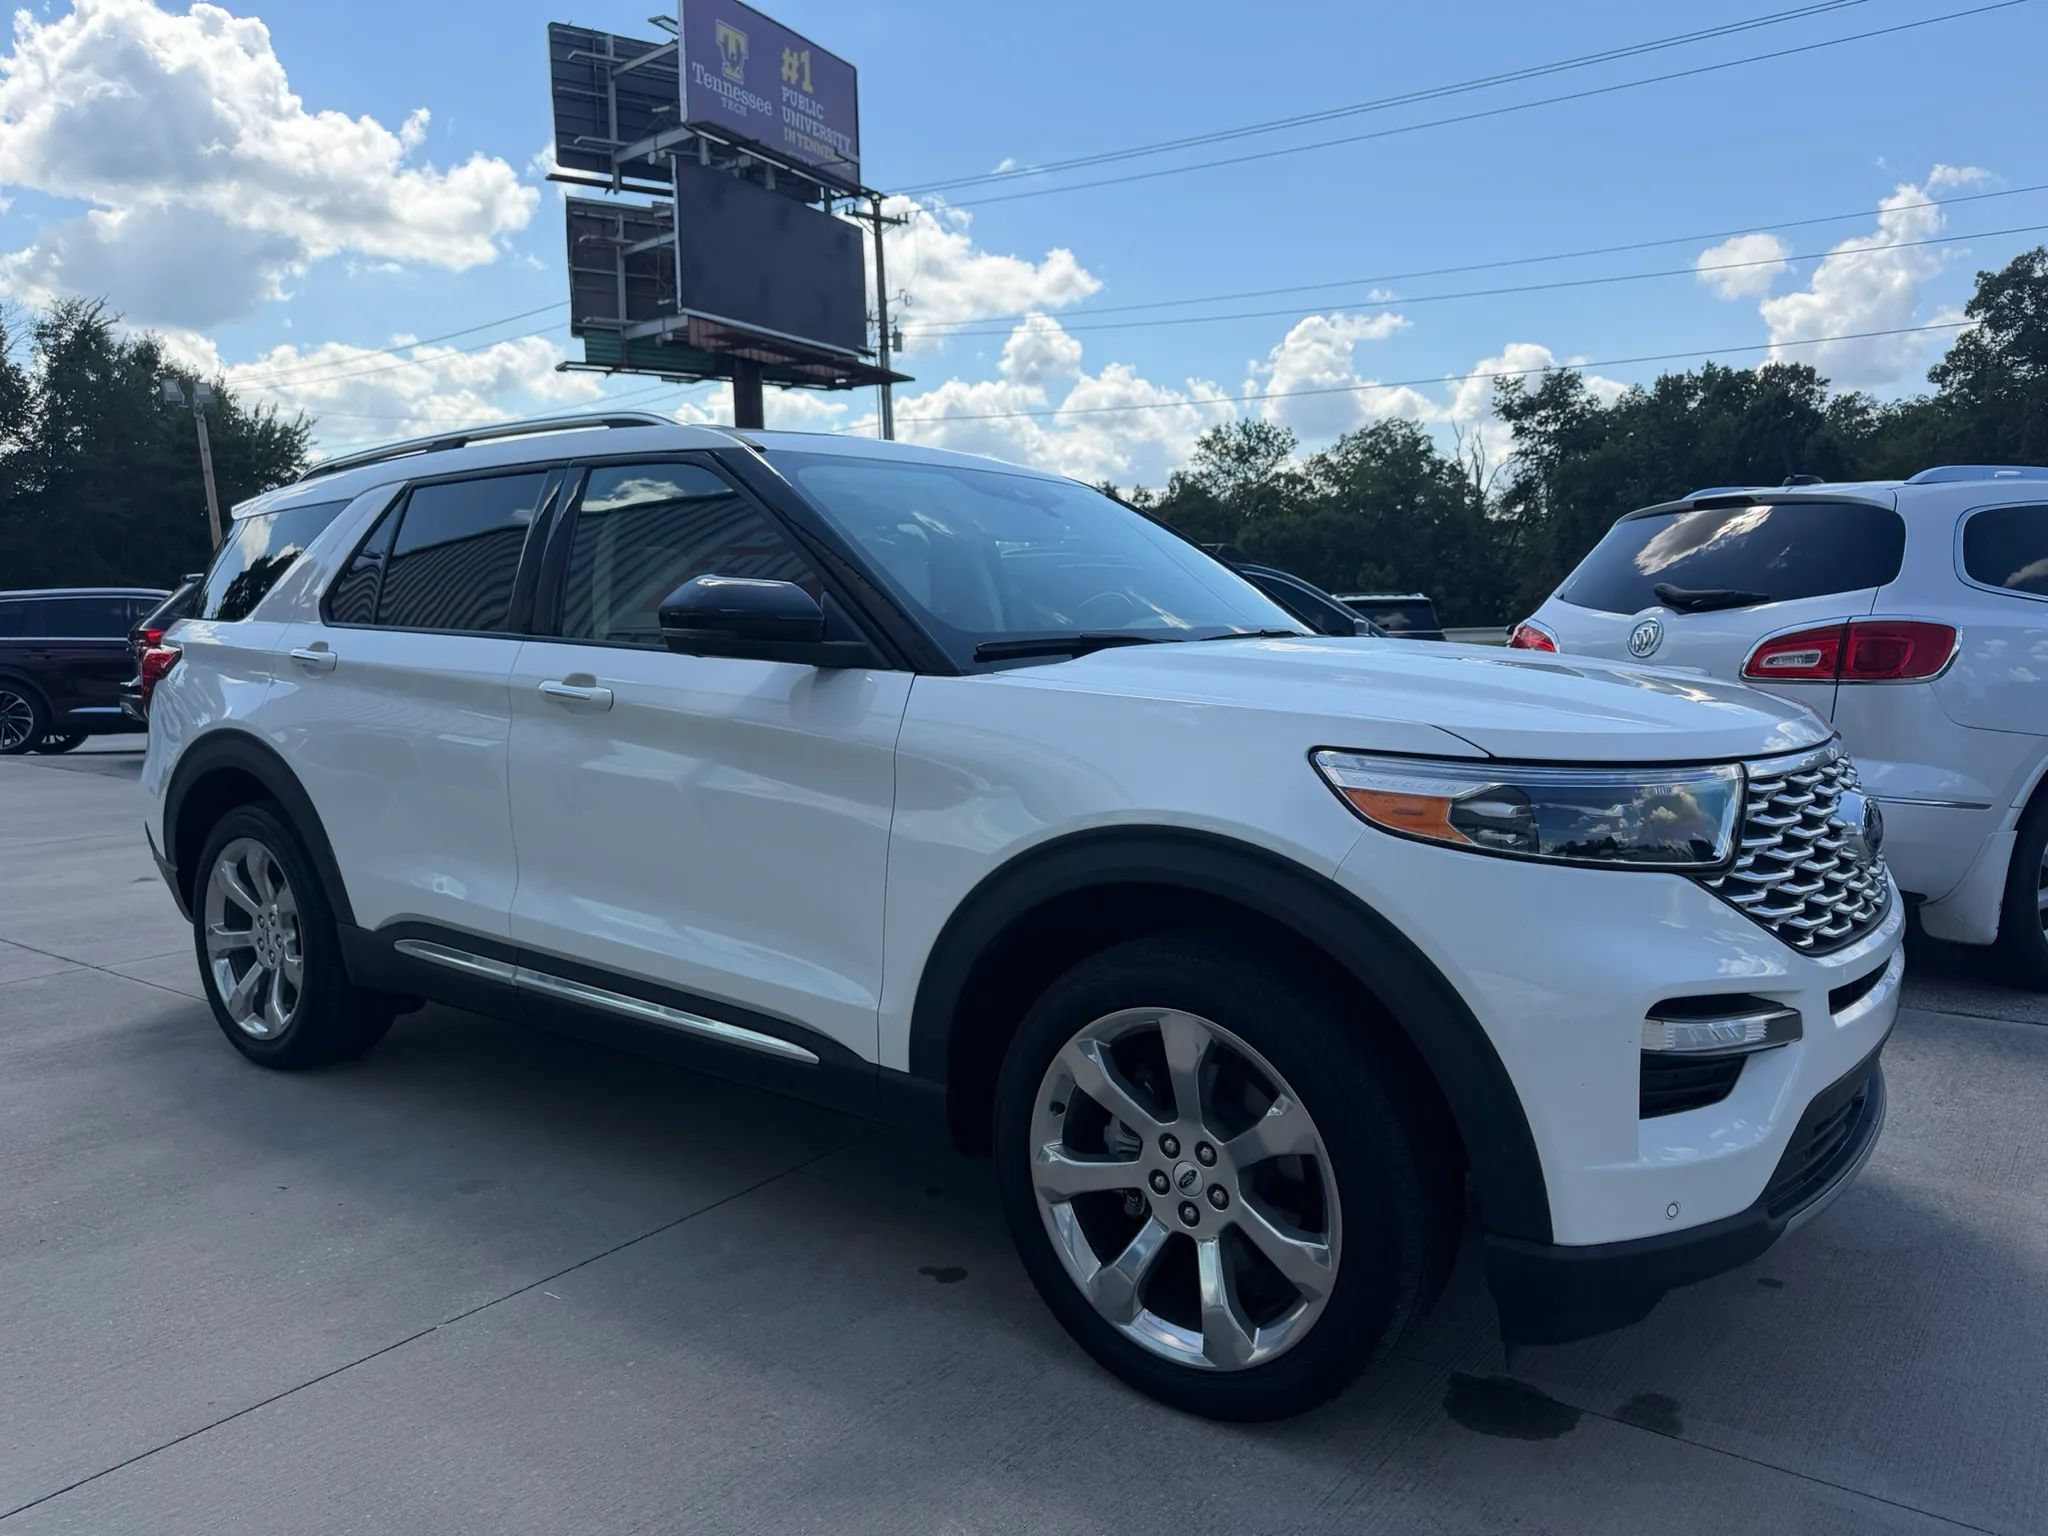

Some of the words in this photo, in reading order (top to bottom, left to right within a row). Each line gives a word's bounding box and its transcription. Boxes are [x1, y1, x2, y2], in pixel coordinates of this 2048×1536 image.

[691, 60, 773, 117] Tennessee
[780, 47, 814, 94] #1
[720, 96, 748, 118] TECH
[781, 85, 825, 121] PUBLIC
[781, 105, 852, 153] UNIVERSITY
[783, 126, 797, 145] IN
